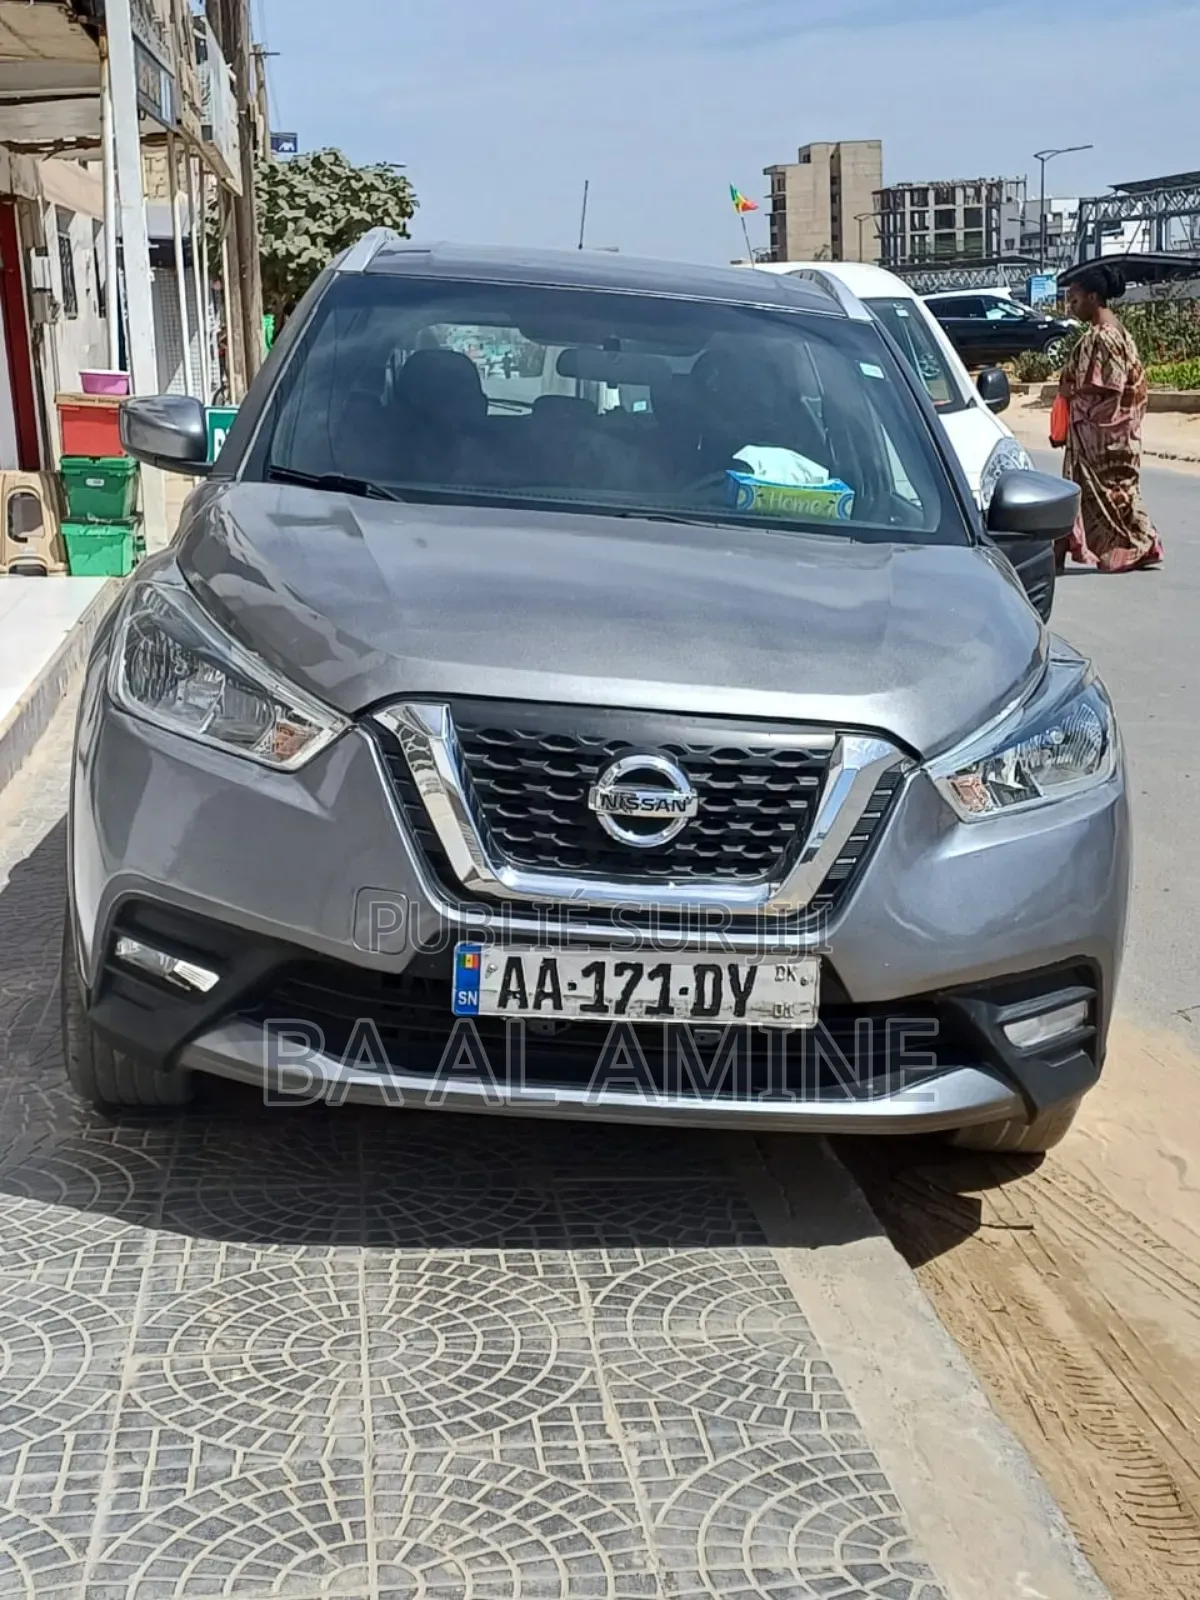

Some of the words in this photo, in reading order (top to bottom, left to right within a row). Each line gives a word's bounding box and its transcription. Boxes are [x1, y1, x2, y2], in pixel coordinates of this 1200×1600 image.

[601, 794, 687, 812] NISSAN
[775, 964, 796, 982] DK
[457, 990, 478, 1006] SN
